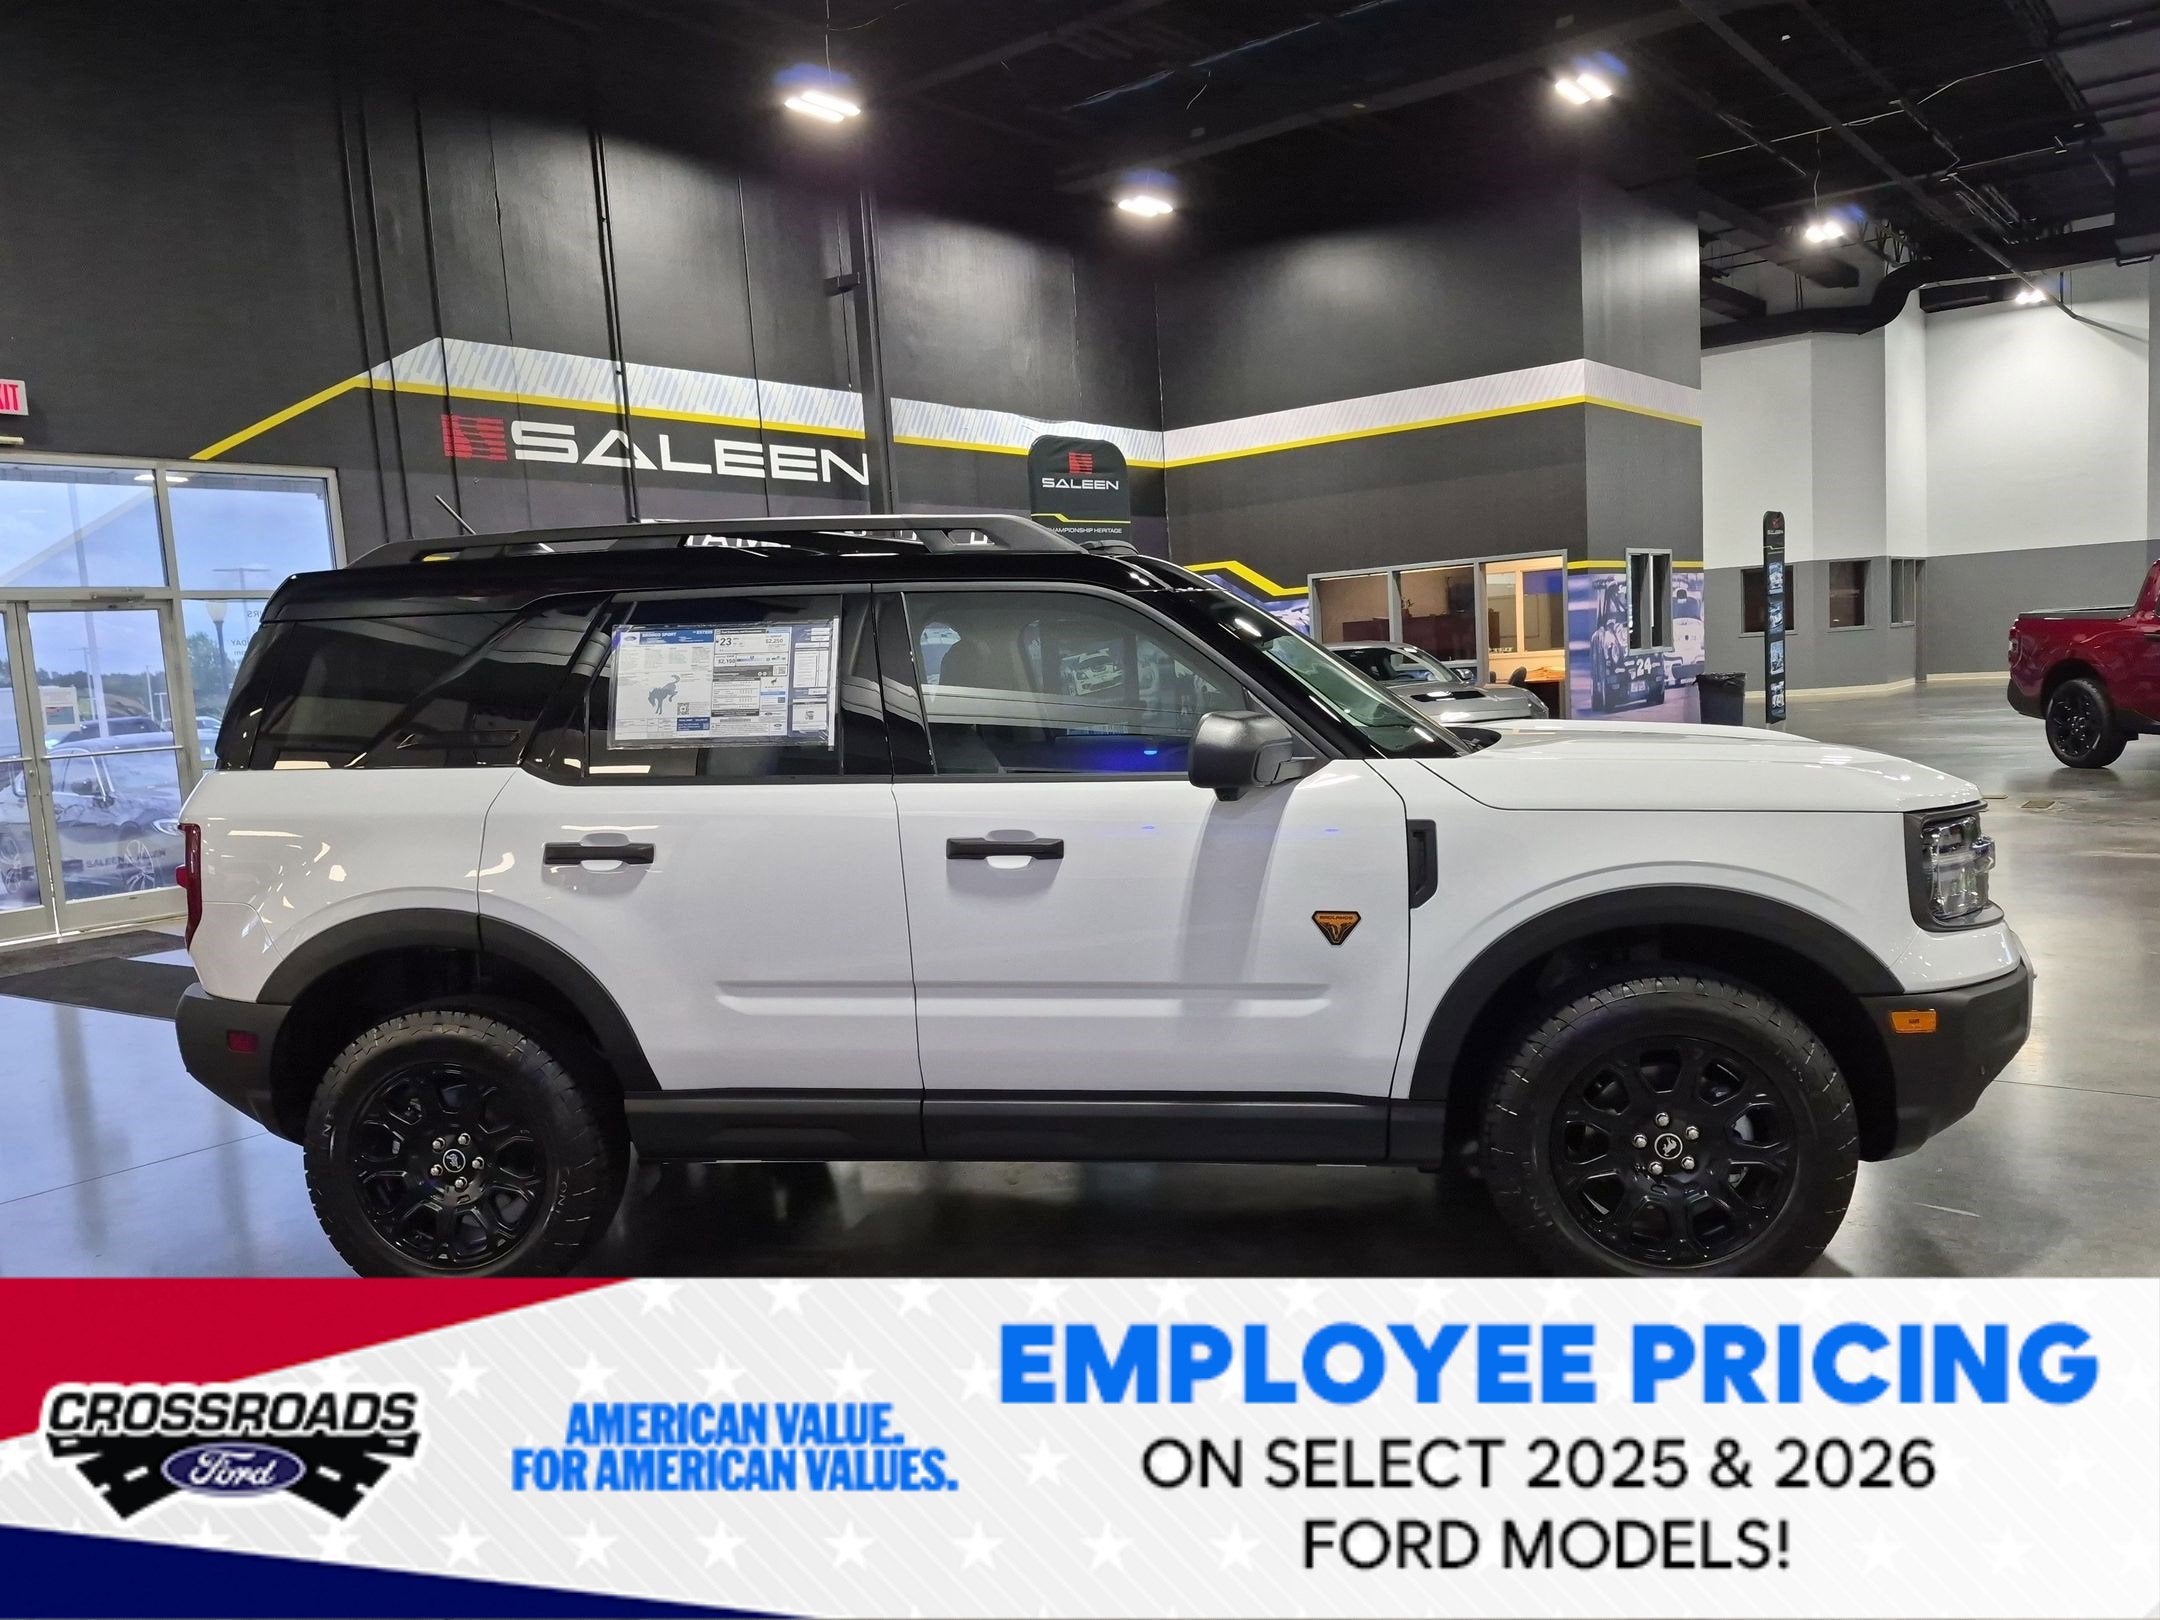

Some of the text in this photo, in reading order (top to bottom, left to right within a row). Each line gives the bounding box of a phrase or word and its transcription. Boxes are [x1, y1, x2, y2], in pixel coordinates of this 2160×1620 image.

[510, 420, 870, 486] SALEEN
[1041, 477, 1120, 491] SALEEN
[719, 637, 732, 646] 23
[1636, 657, 1652, 677] 24
